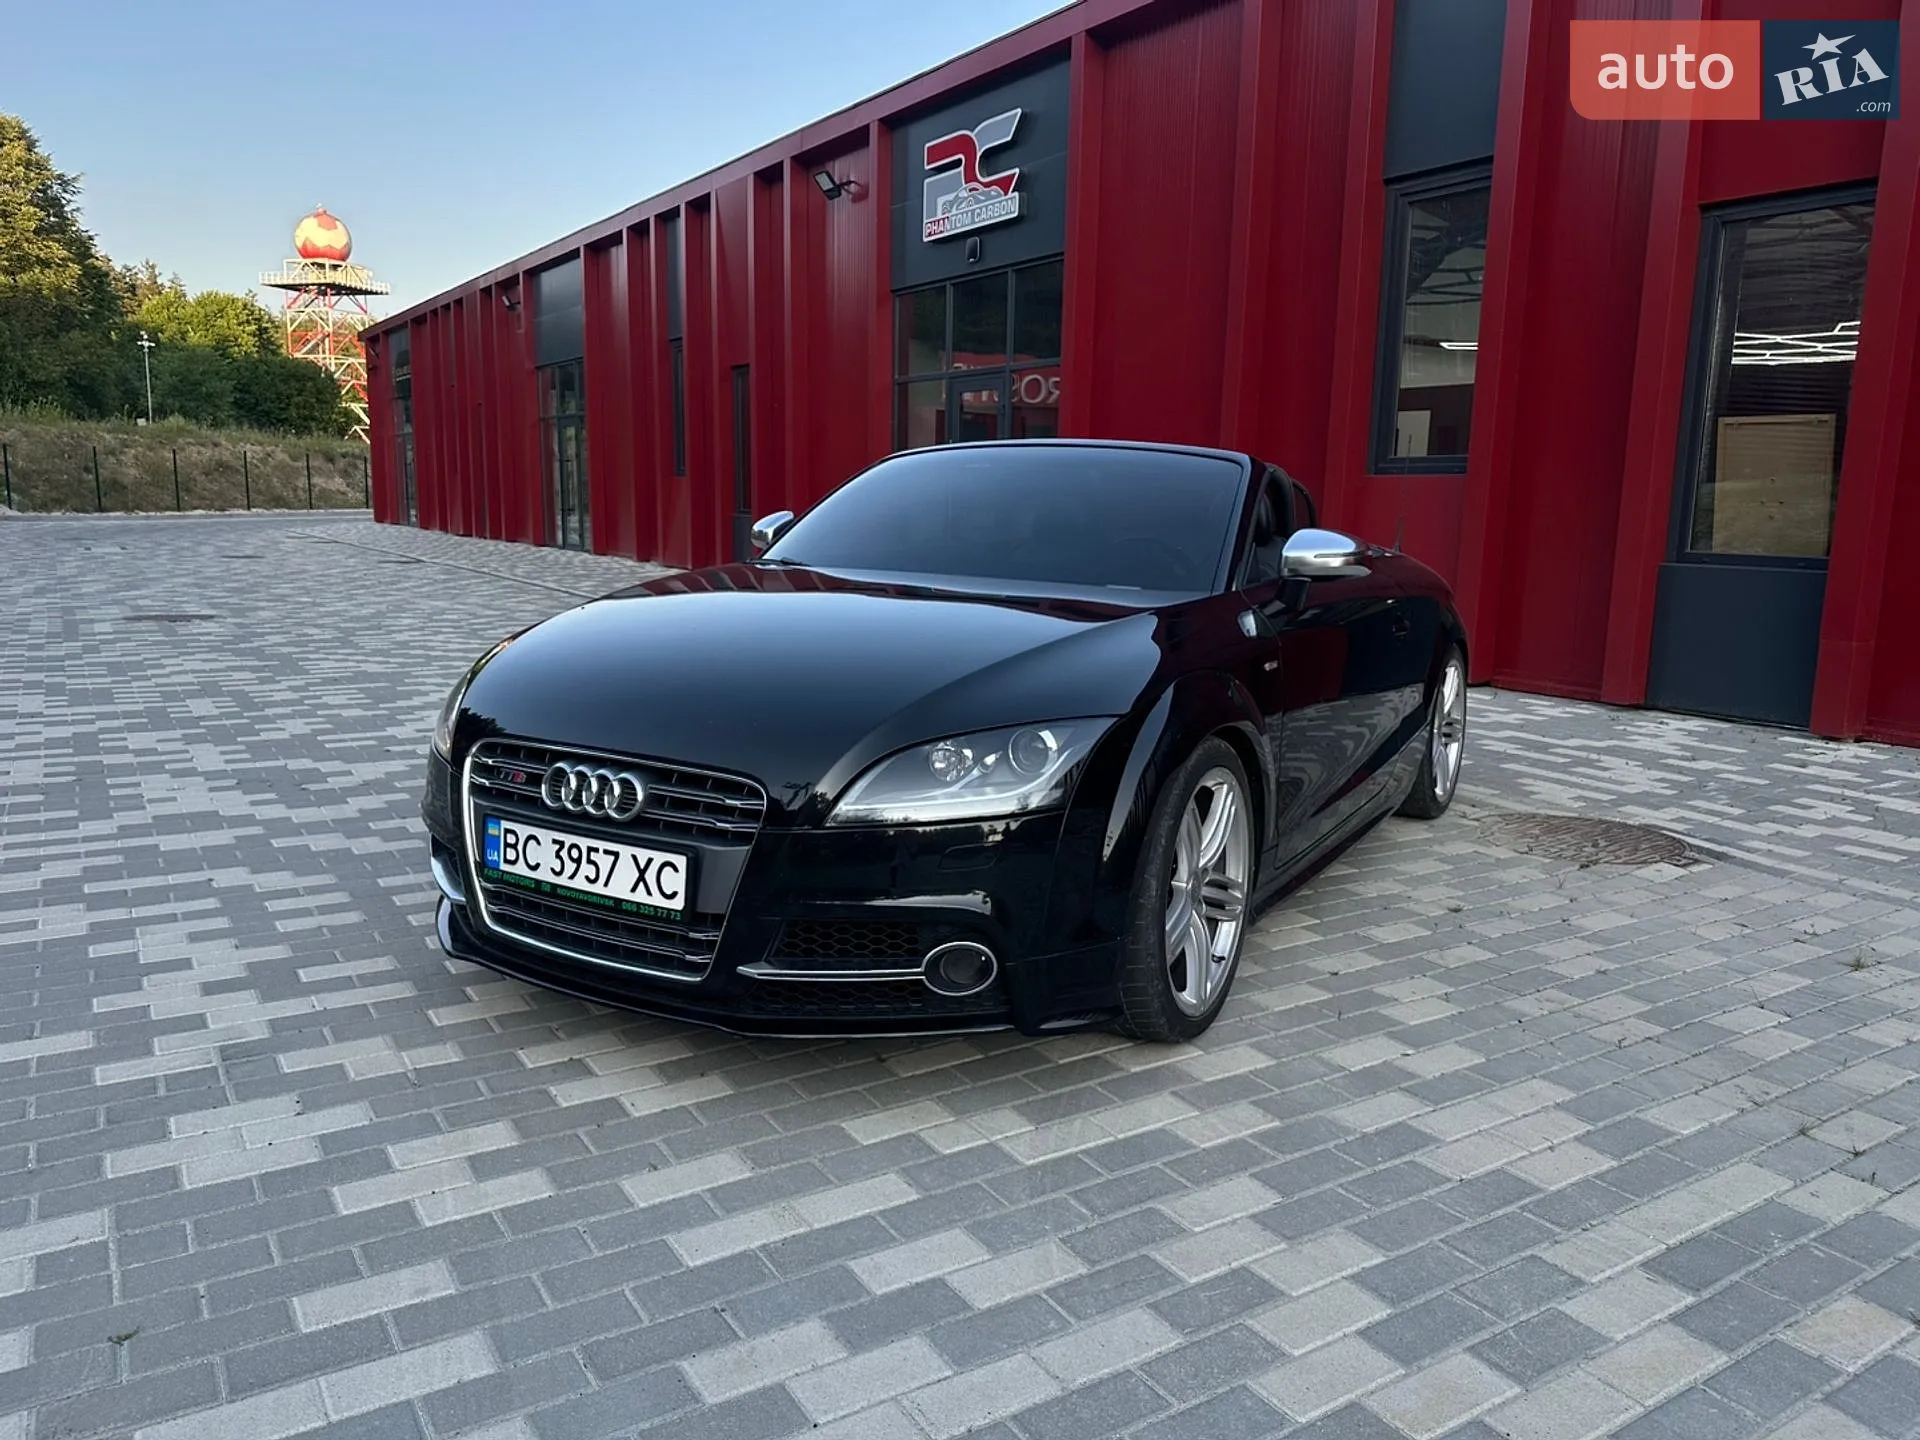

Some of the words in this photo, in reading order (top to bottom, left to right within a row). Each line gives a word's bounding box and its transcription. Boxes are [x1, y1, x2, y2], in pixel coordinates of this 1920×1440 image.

[925, 211, 972, 237] PHANTOM
[974, 197, 1016, 222] CARBON
[486, 848, 499, 862] UA
[502, 827, 542, 872] BC
[550, 838, 620, 888] 3957
[630, 853, 680, 901] XC
